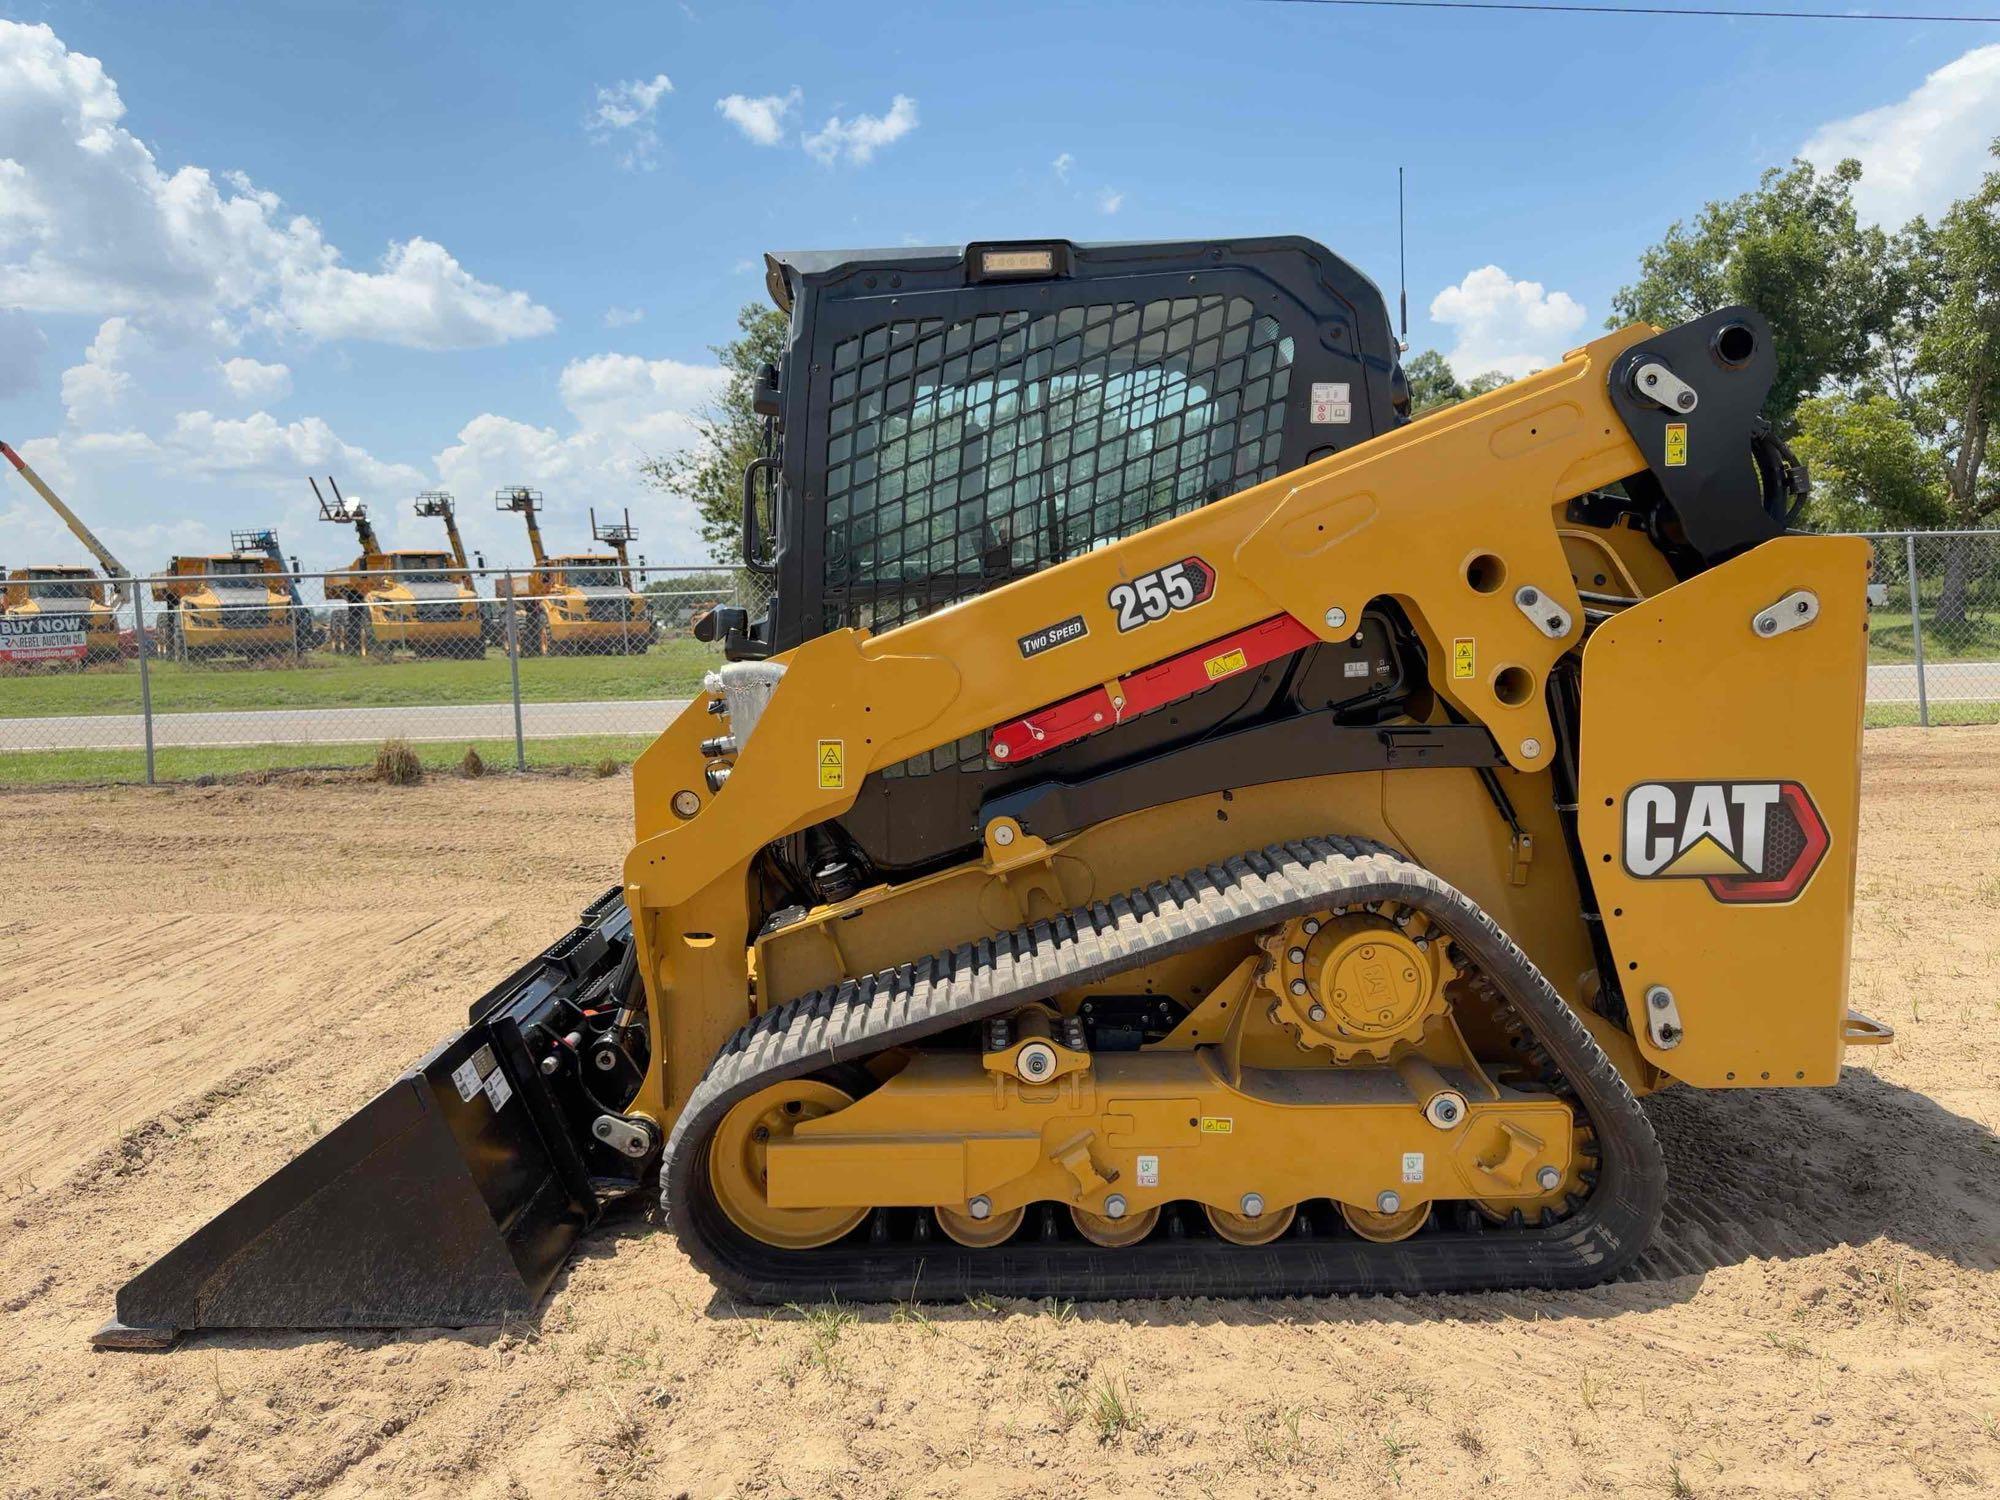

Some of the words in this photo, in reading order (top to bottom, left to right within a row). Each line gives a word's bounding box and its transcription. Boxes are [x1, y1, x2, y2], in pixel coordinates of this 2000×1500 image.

[1110, 563, 1194, 630] 255
[1, 621, 32, 634] BUY
[39, 618, 80, 631] NOW
[20, 636, 40, 648] REBEL
[42, 634, 72, 646] AUCTION
[1626, 784, 1780, 876] CAT
